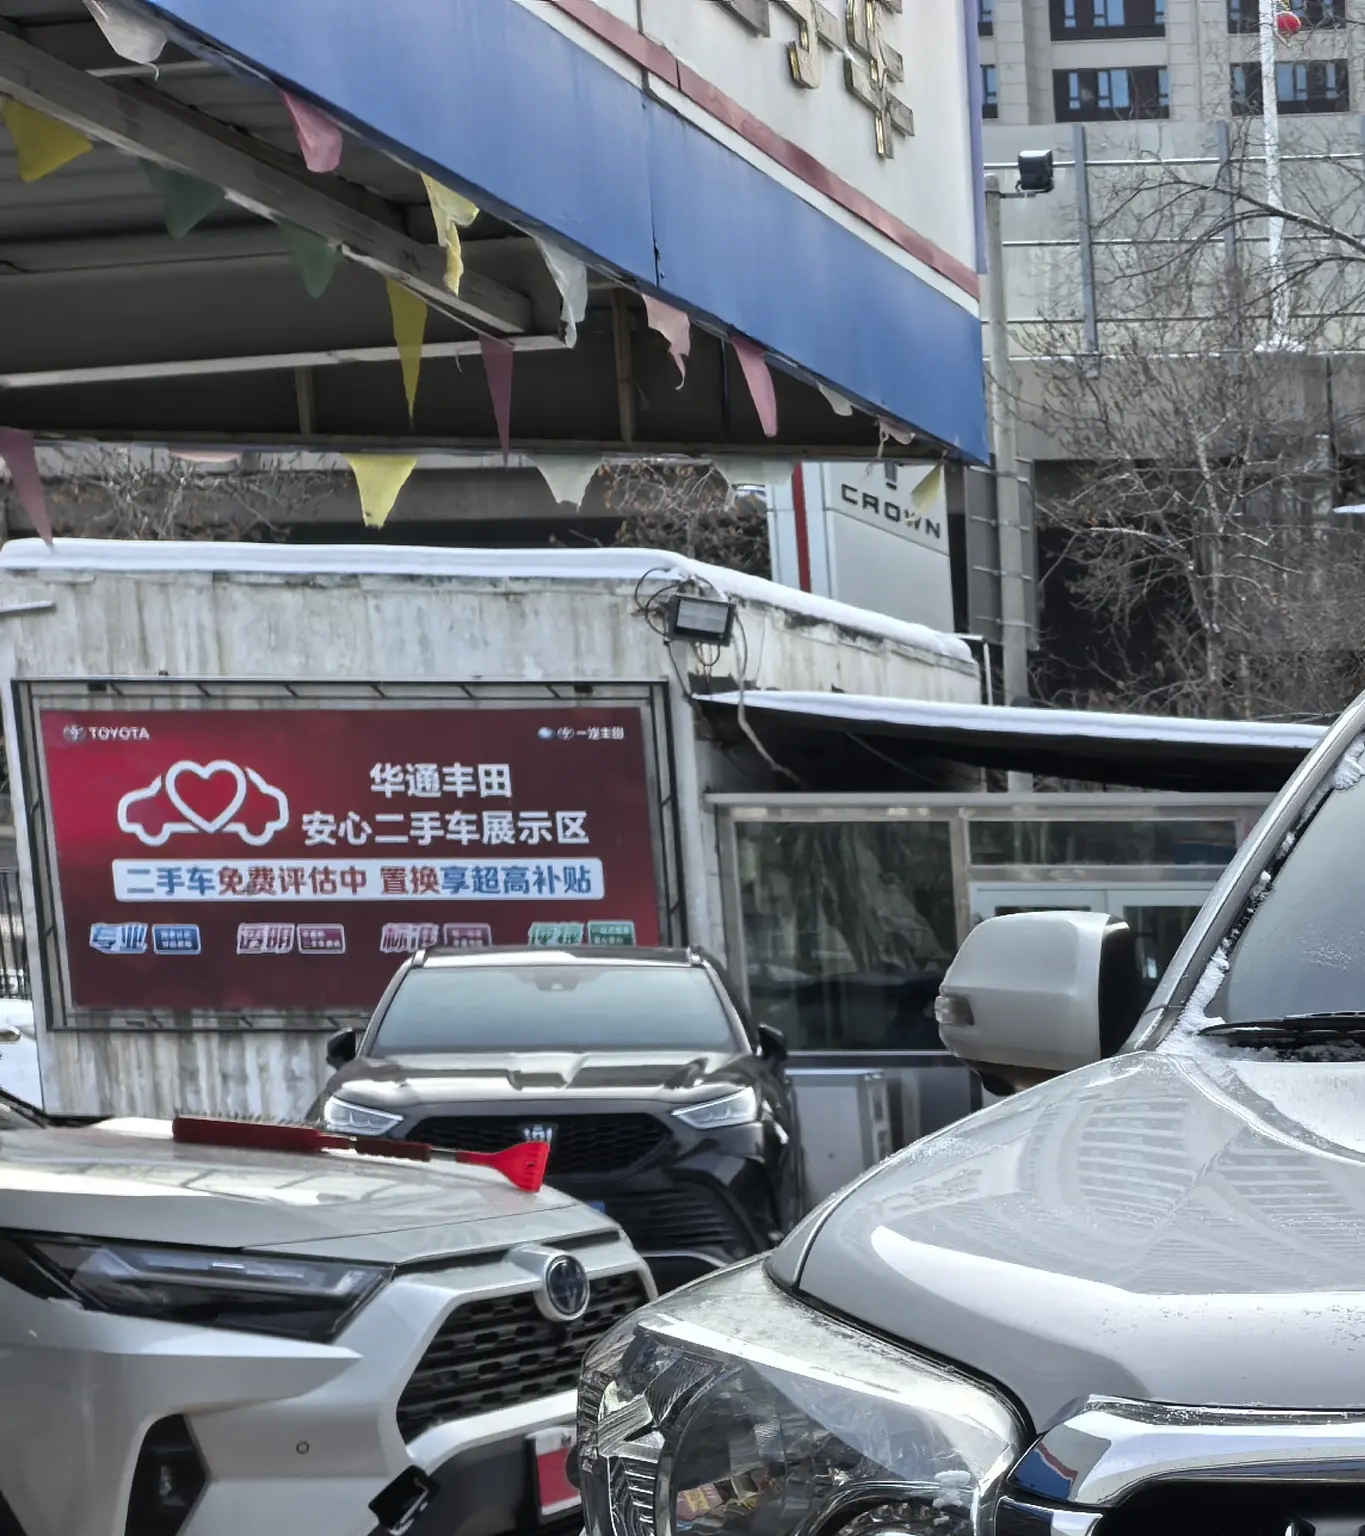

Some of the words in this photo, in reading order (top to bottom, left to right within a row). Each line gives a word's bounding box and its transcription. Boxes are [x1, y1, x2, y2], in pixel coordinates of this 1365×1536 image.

[88, 726, 150, 740] TOYOTA
[369, 762, 513, 798] 华通丰田
[301, 810, 590, 846] 安心二手车展示区
[126, 865, 368, 896] 二手车免费评估中
[380, 864, 593, 895] 置换享超高补贴
